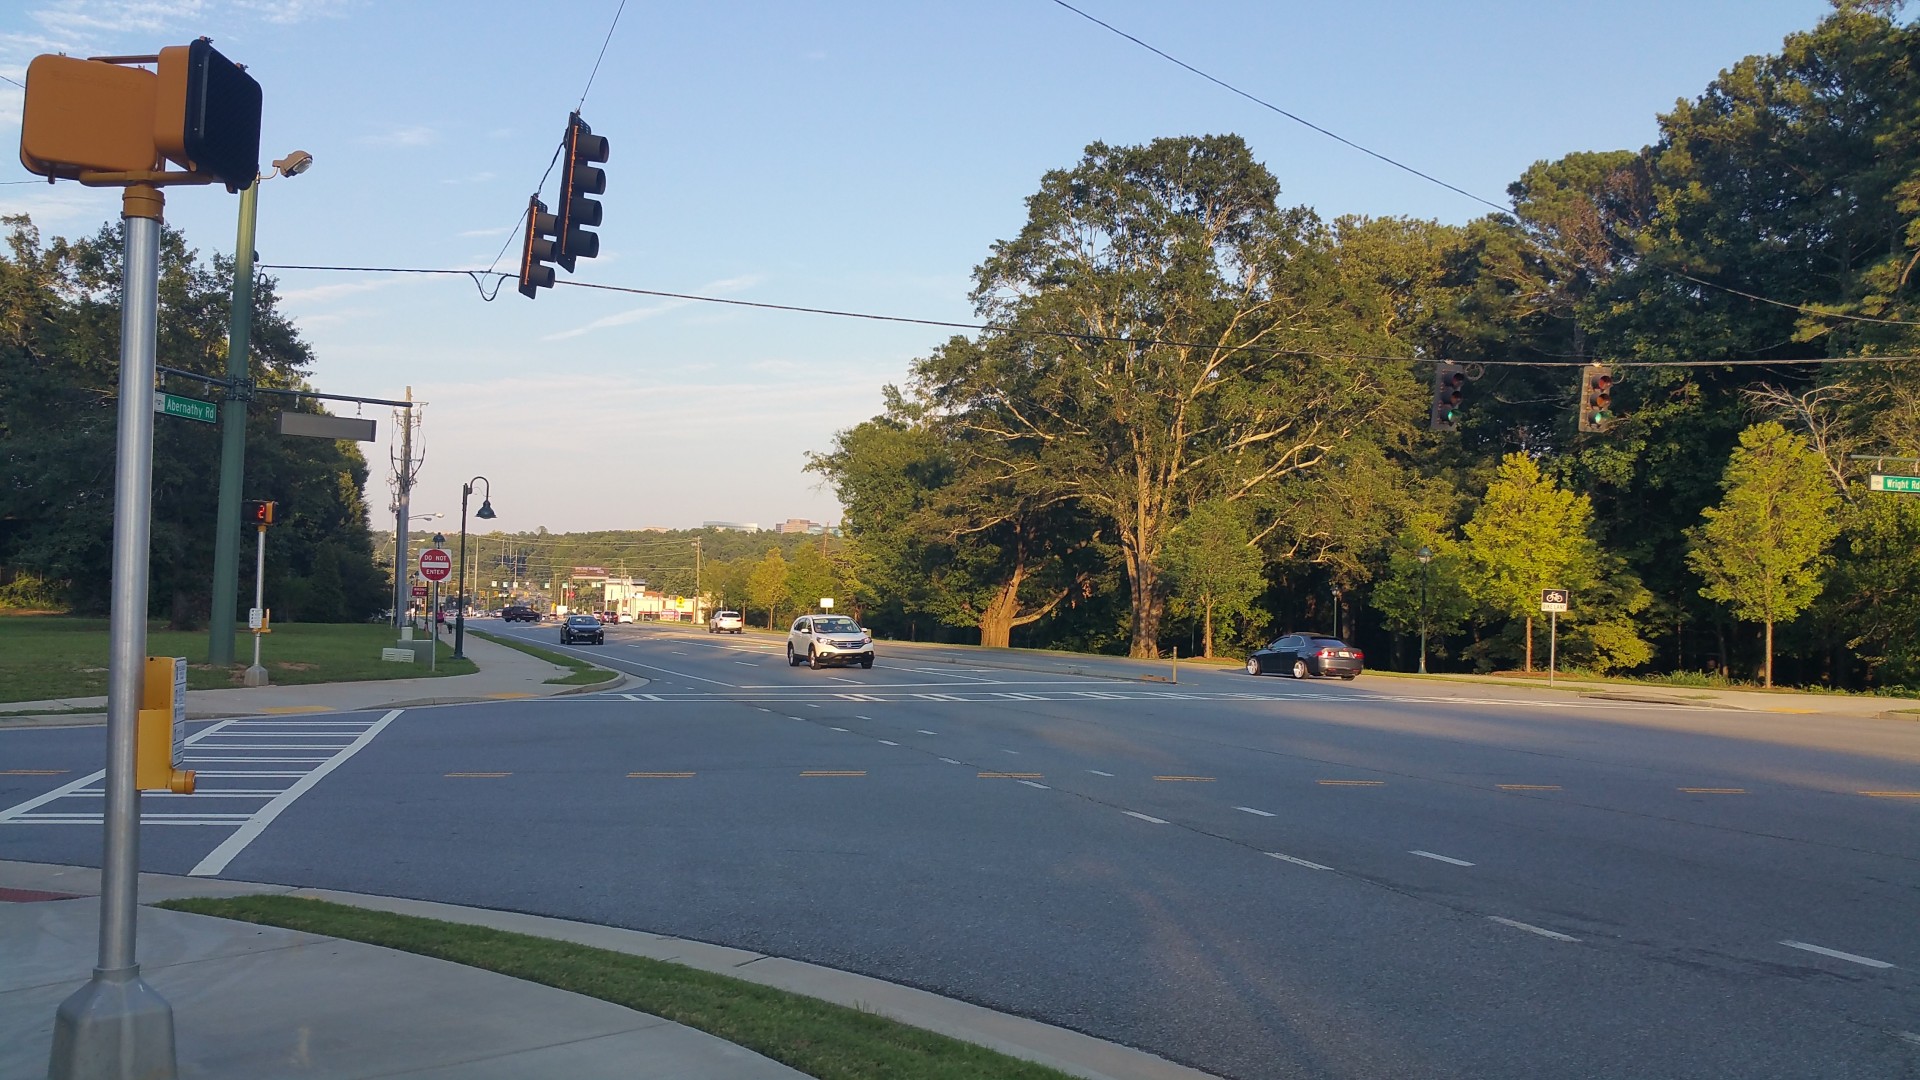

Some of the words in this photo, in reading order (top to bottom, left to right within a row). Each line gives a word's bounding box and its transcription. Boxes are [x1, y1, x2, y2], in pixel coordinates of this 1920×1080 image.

[167, 399, 203, 418] Abernathy
[205, 406, 214, 419] Rd
[1886, 478, 1909, 490] Wright
